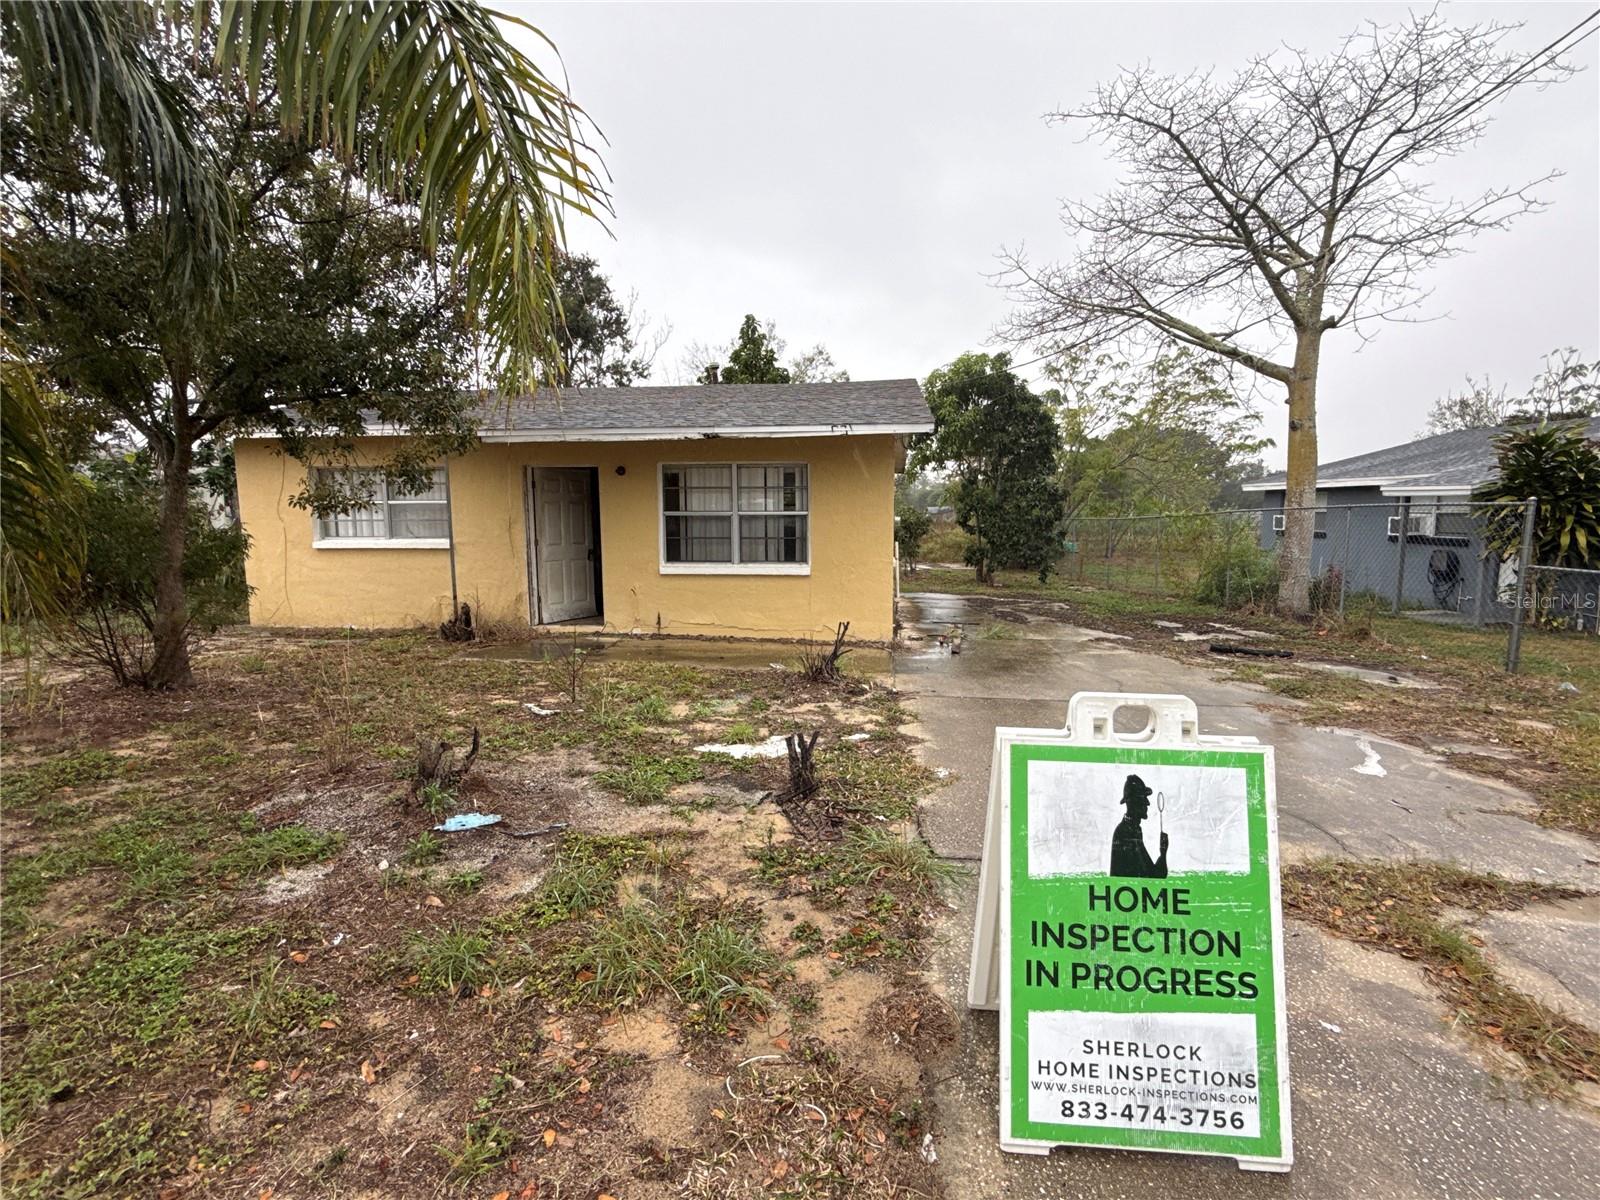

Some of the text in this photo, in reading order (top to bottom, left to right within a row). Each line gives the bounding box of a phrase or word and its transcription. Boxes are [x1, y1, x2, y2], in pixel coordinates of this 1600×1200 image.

[1088, 885, 1192, 916] HOME
[1031, 921, 1242, 959] INSPECTION
[1025, 959, 1259, 999] IN PROGRESS
[1083, 1039, 1203, 1062] SHERLOCK
[1038, 1060, 1257, 1089] HOME INSPECTIONS
[1031, 1080, 1258, 1105] WWW.SHERLOCK-INSPECTIONS.COM
[1061, 1100, 1245, 1130] 833-474-3756
